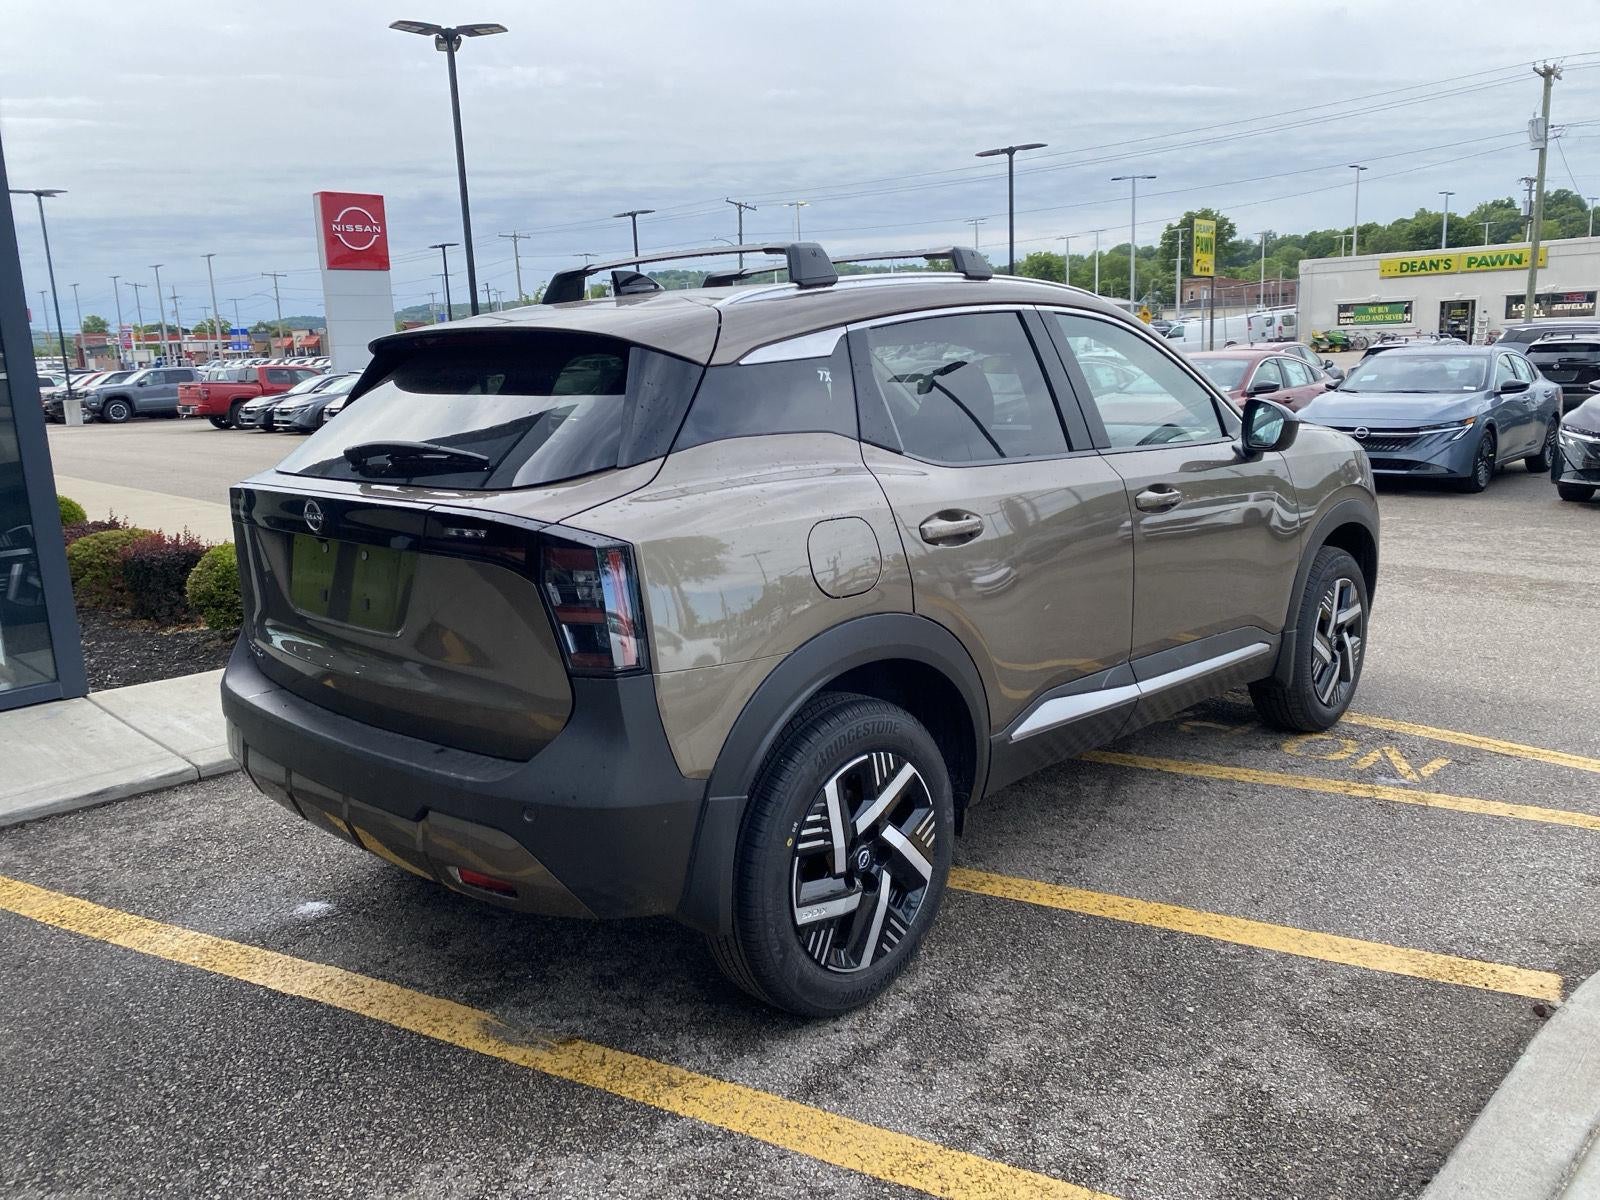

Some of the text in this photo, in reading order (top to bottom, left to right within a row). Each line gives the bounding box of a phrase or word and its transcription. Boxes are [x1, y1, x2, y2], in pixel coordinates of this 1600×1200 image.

[332, 224, 381, 233] NISSAN
[1195, 236, 1214, 256] PAWN
[1512, 302, 1595, 311] LON JEWELRY
[1355, 314, 1371, 322] GOLD
[814, 720, 900, 768] BRIDGESTONE
